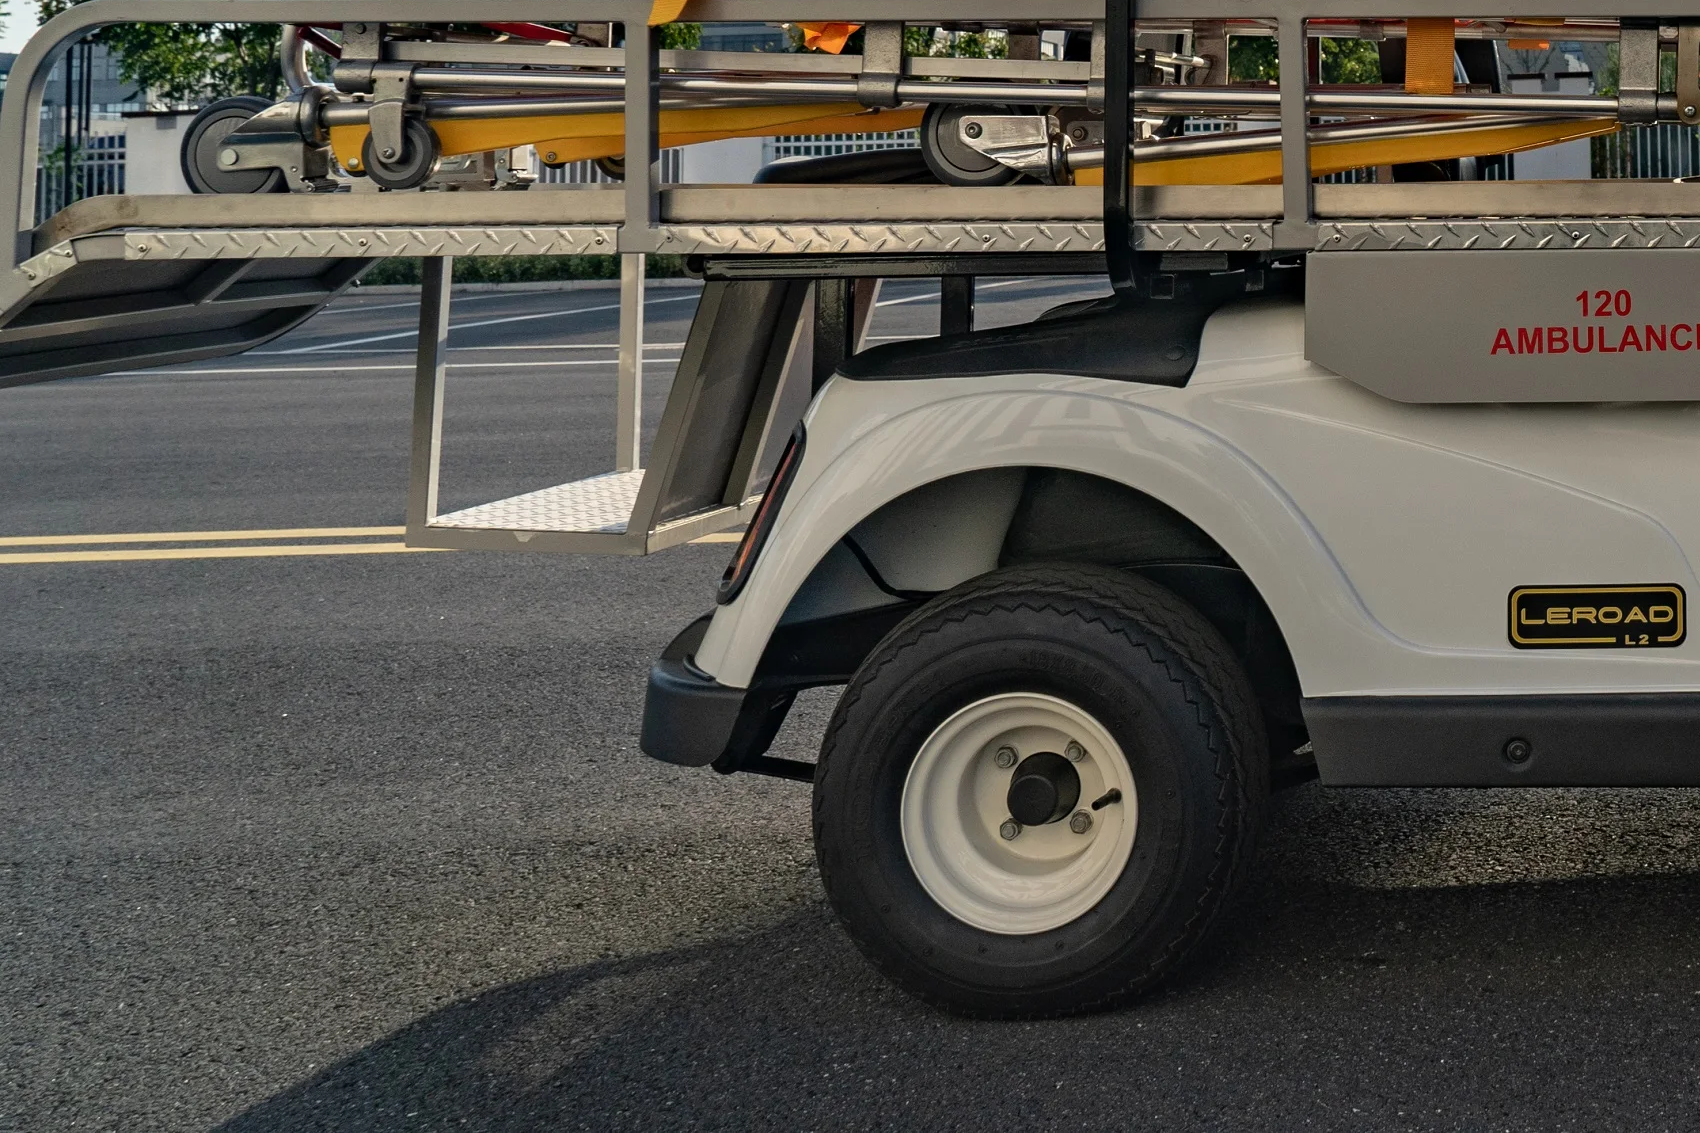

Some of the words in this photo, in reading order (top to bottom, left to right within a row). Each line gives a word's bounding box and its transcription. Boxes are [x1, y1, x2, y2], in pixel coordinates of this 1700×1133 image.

[1576, 289, 1632, 317] 120
[1521, 606, 1673, 625] LEROAD
[1624, 634, 1649, 645] L2
